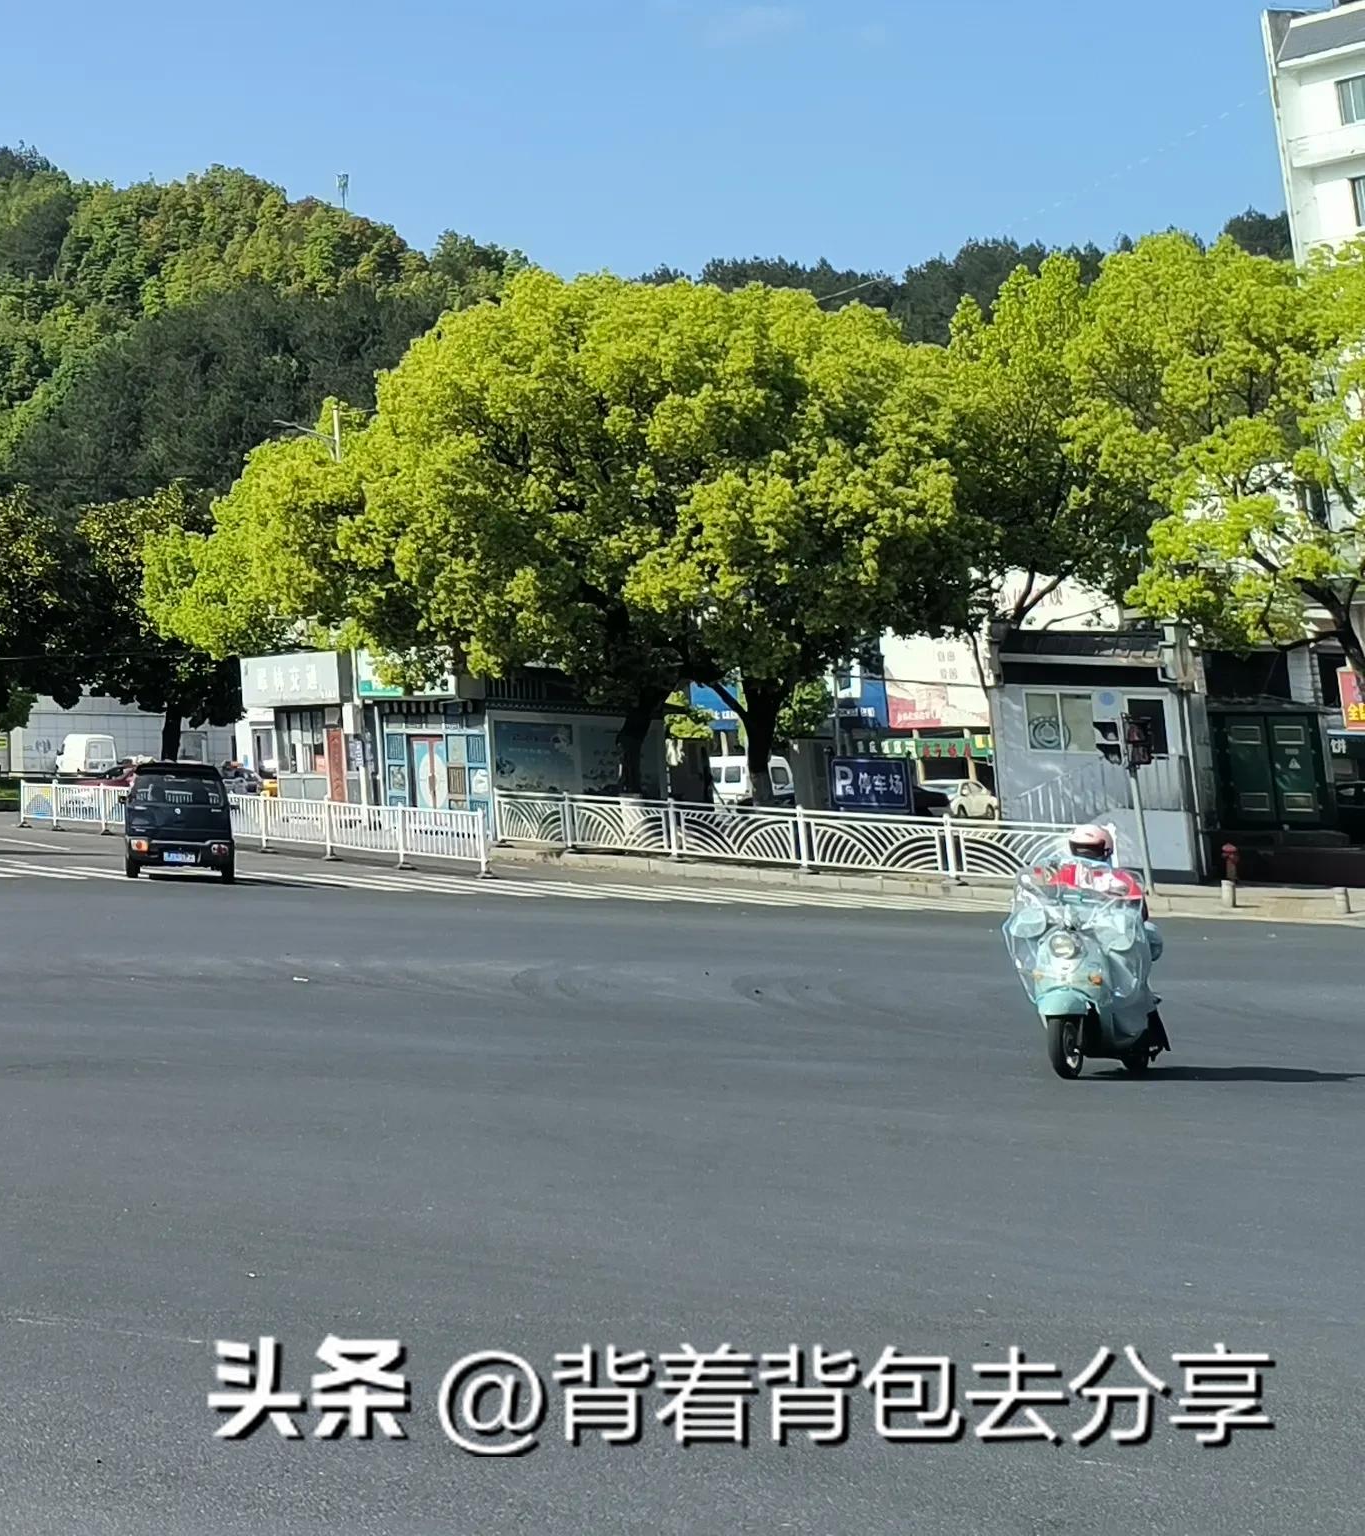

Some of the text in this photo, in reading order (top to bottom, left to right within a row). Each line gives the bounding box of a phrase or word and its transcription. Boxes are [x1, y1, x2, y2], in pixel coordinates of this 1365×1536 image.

[835, 766, 854, 796] P
[858, 772, 903, 795] 停车场
